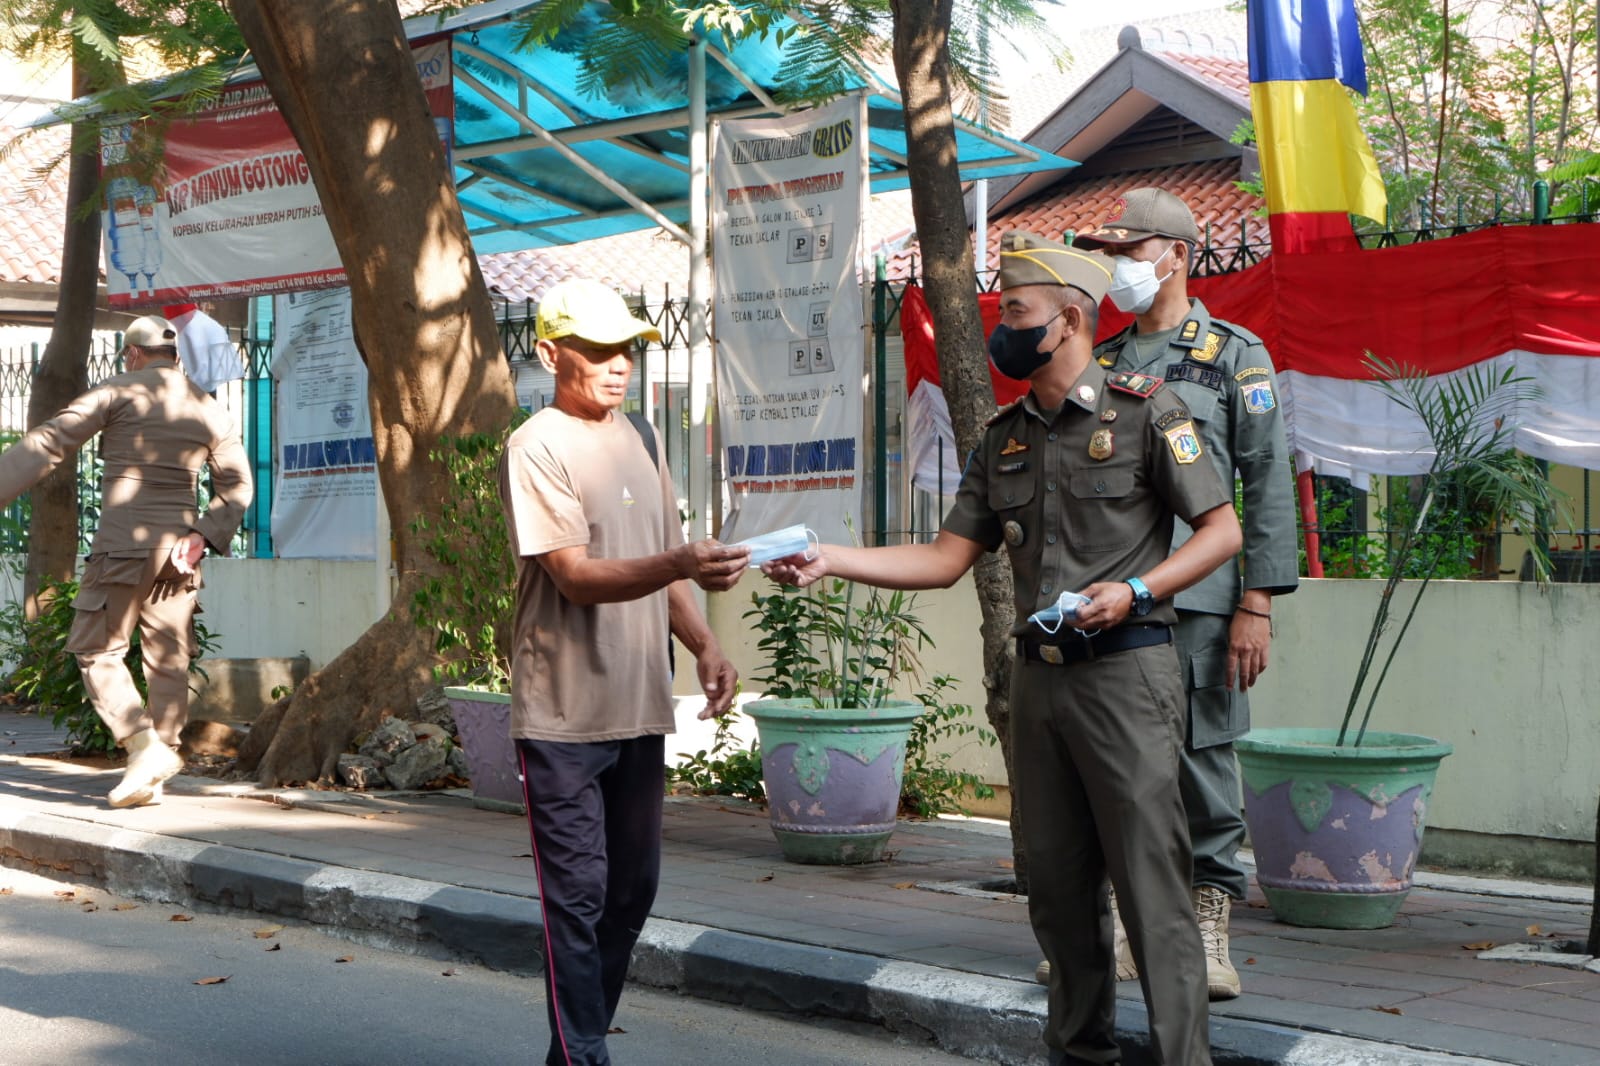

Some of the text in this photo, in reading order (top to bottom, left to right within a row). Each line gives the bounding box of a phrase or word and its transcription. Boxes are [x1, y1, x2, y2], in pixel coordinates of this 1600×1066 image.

[813, 119, 853, 157] GRATIS
[164, 151, 309, 218] AIR MINUM GOTONG
[172, 223, 205, 238] KOPERASI
[204, 214, 255, 233] KELURAHAN
[256, 210, 286, 226] MERAH
[287, 206, 311, 222] PUTIH
[796, 238, 806, 250] P
[819, 234, 827, 247] S
[294, 277, 305, 287] RW
[796, 350, 805, 363] P
[815, 347, 823, 361] S
